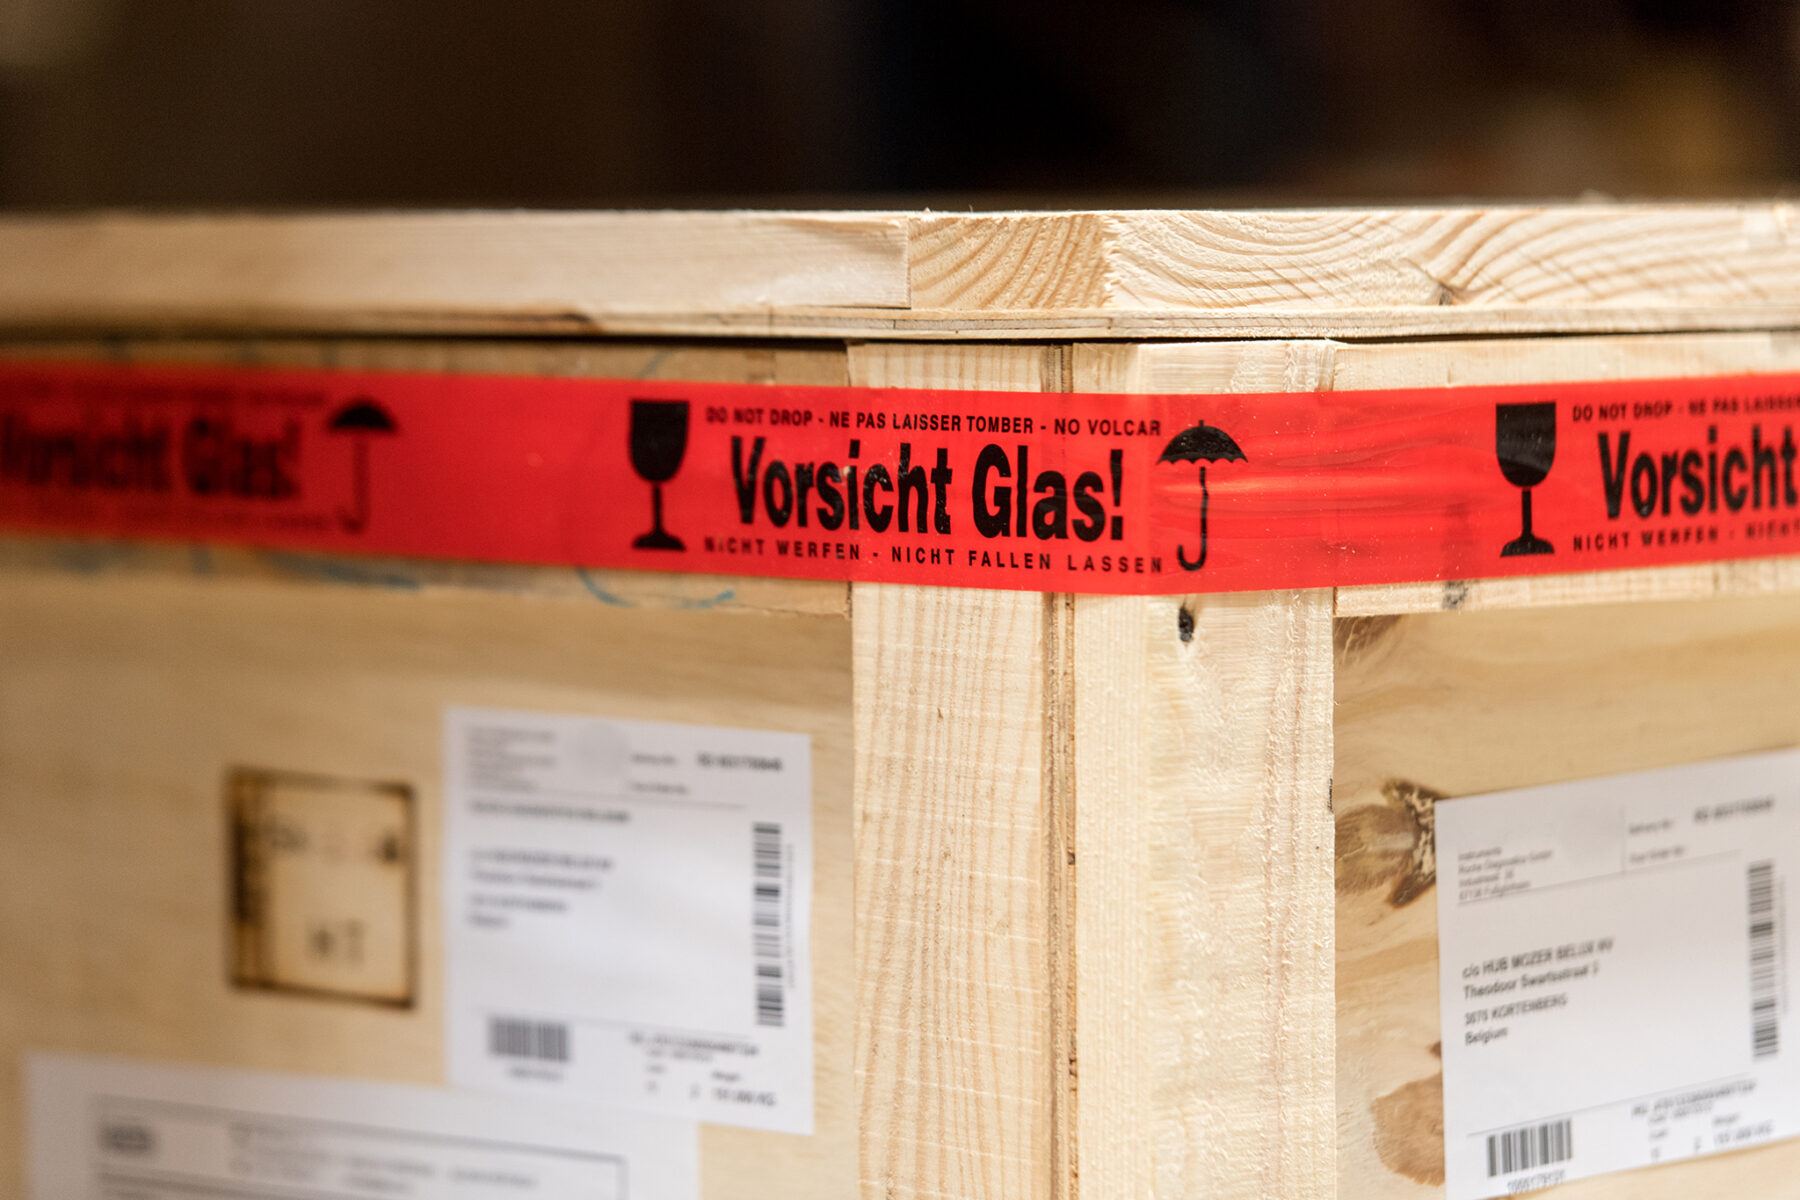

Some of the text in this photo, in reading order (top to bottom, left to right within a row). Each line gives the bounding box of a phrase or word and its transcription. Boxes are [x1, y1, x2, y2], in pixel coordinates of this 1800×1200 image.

[706, 407, 727, 424] DO
[733, 408, 763, 425] NOT
[770, 409, 813, 427] DROP
[830, 411, 850, 428] NE
[857, 412, 886, 430] PAS
[893, 413, 961, 432] LAISSER
[967, 415, 1033, 434] TOMBER
[1054, 418, 1080, 435] NO
[1088, 419, 1161, 436] VOLCAR
[1573, 404, 1593, 422] DO
[1599, 402, 1627, 420] NOT
[1597, 423, 1798, 521] Vorsicht
[731, 436, 1124, 543] Vorsicht Glas!
[1573, 532, 1629, 551] NICHT
[704, 536, 764, 555] NICHT
[776, 540, 860, 560] WERFEN
[892, 546, 955, 565] NICHT
[968, 550, 1051, 570] FALLEN
[1067, 554, 1163, 573] LASSEN
[1482, 956, 1508, 974] HUB
[1464, 1027, 1508, 1047] Belgium
